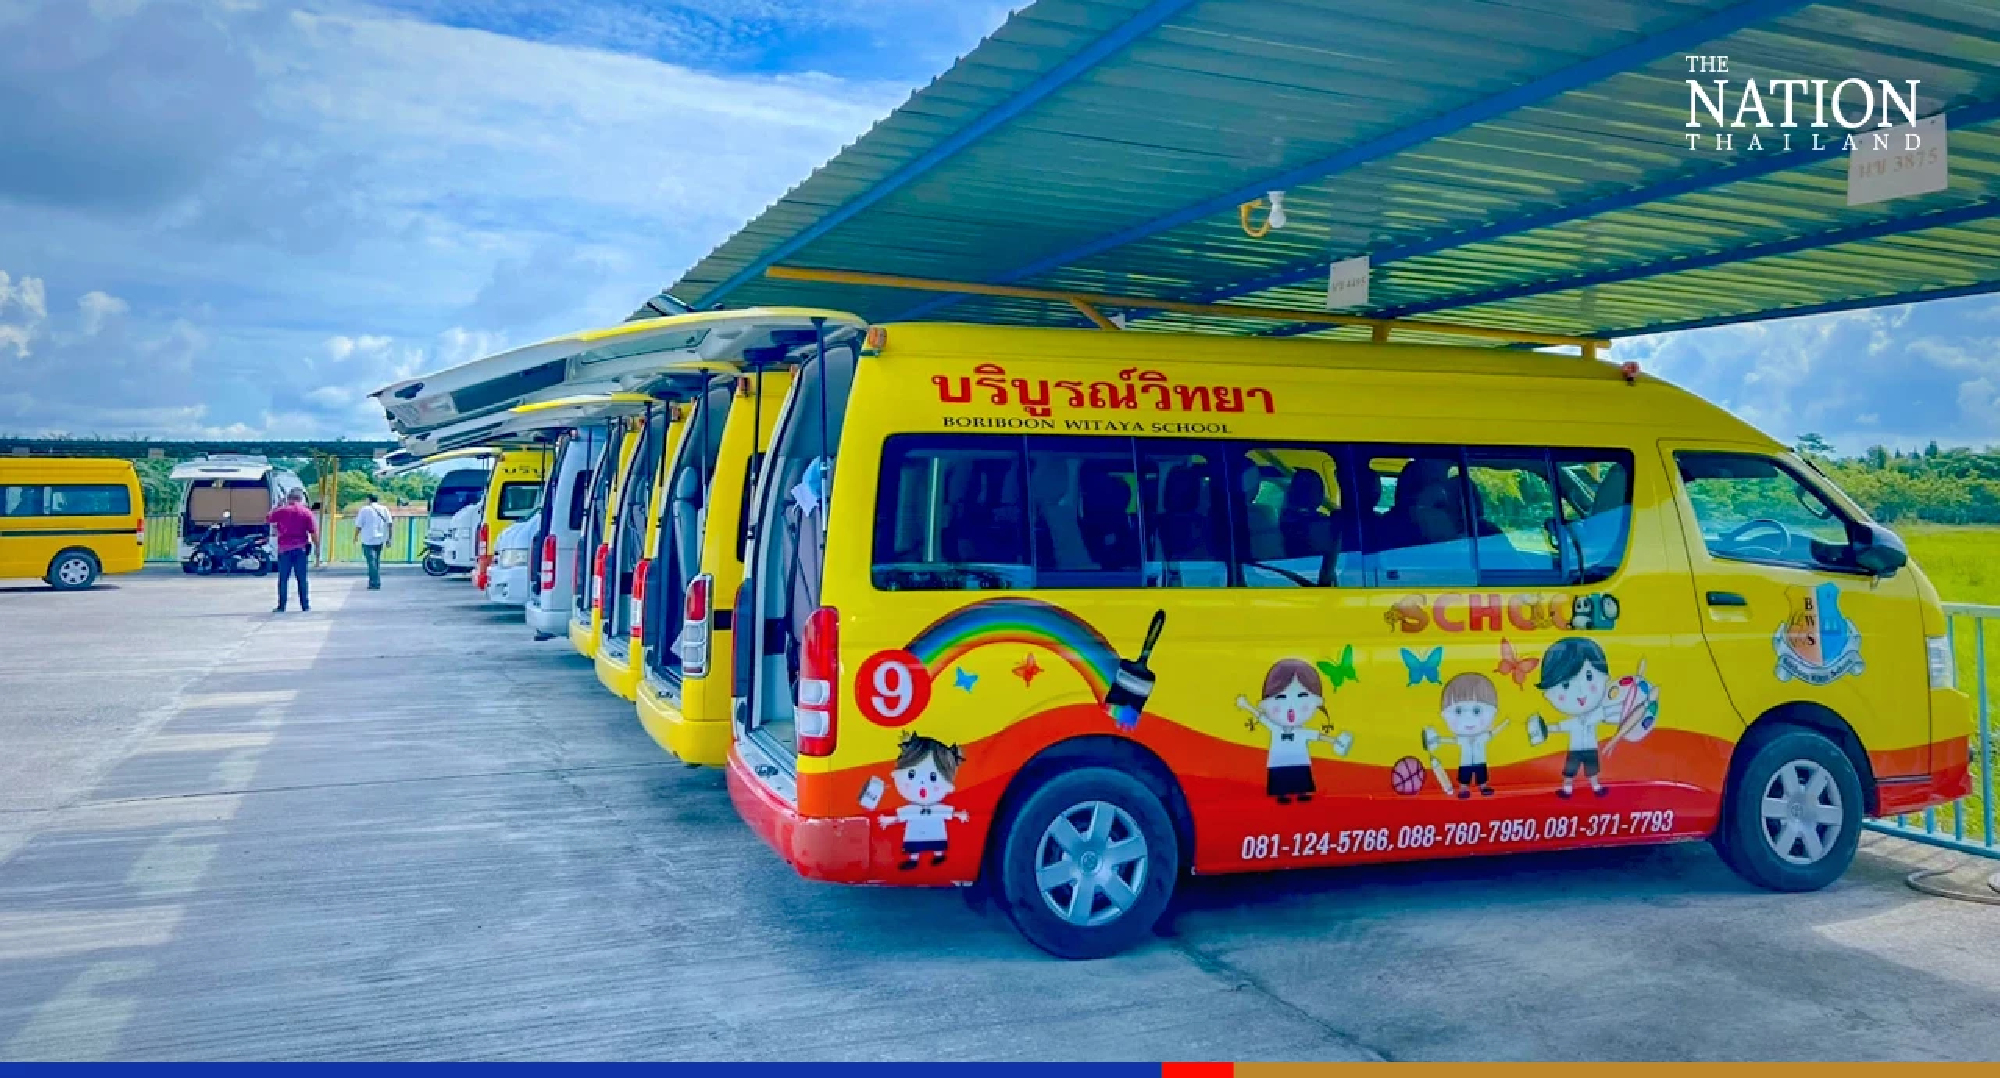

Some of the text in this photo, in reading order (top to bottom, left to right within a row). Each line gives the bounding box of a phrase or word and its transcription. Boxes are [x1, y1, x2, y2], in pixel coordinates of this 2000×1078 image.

[1893, 147, 1938, 173] 3875
[932, 363, 1276, 417] บริบูรณ์วิทยา
[942, 416, 1233, 433] BORIBOON WITAYA SCHOOL
[872, 660, 913, 717] 9
[1544, 811, 1674, 840] 081-371-7793
